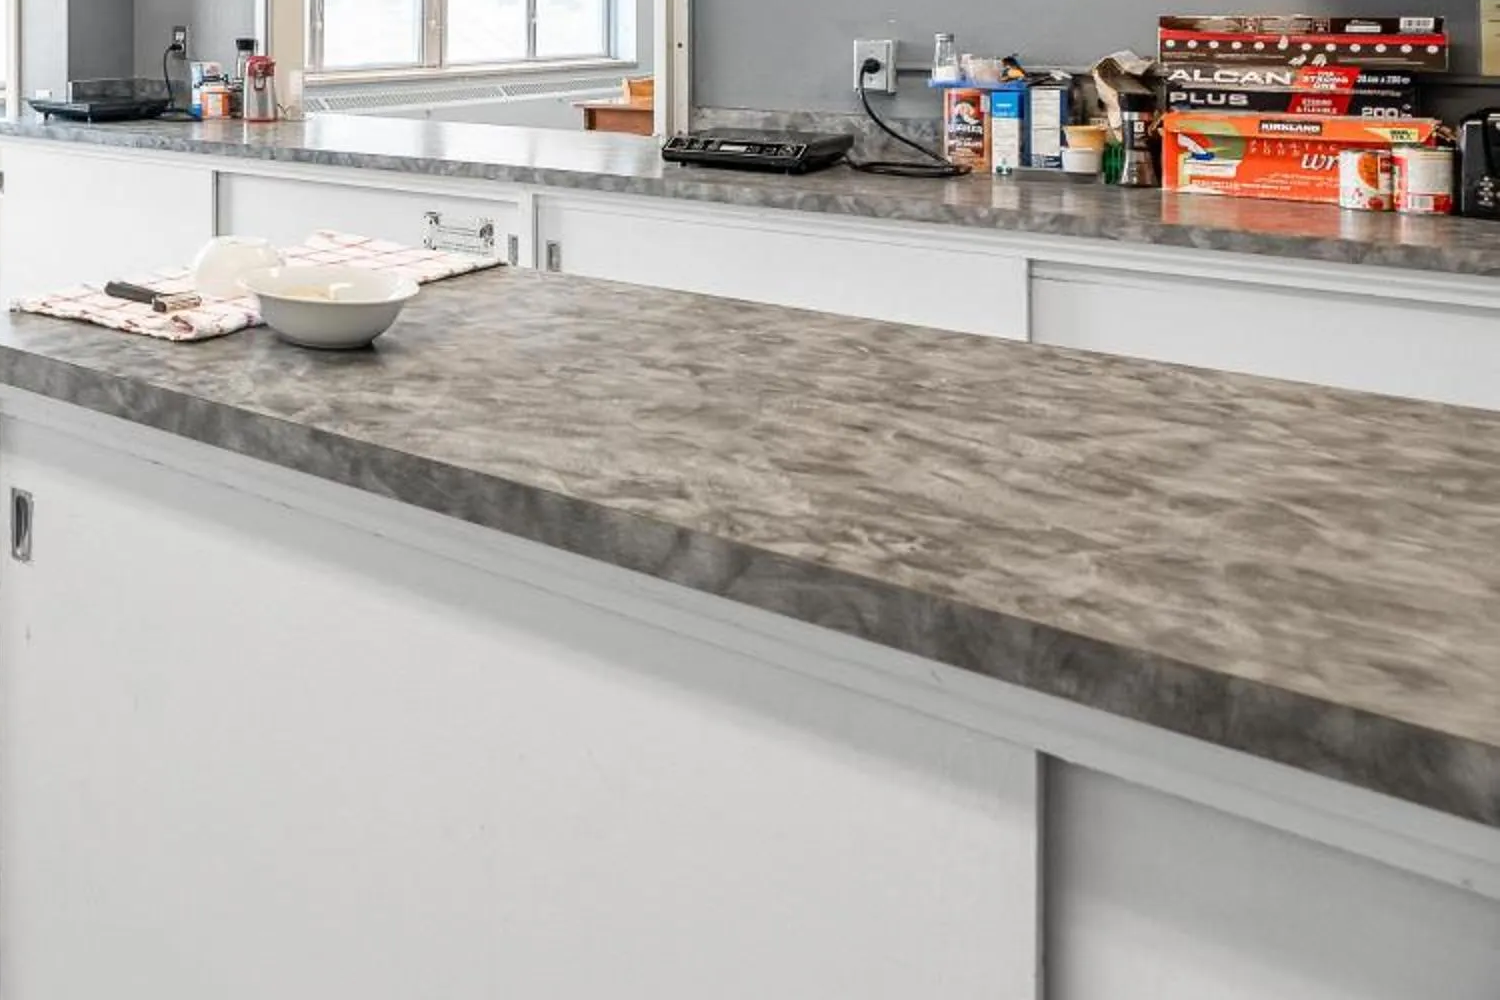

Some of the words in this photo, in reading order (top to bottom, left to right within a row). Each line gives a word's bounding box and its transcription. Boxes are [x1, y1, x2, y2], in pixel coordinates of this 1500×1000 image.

[1167, 68, 1293, 86] ALCAN
[1169, 91, 1250, 107] PLUS
[1361, 106, 1399, 119] 200
[1261, 122, 1321, 133] KIRKLAND
[1301, 153, 1341, 171] wr
